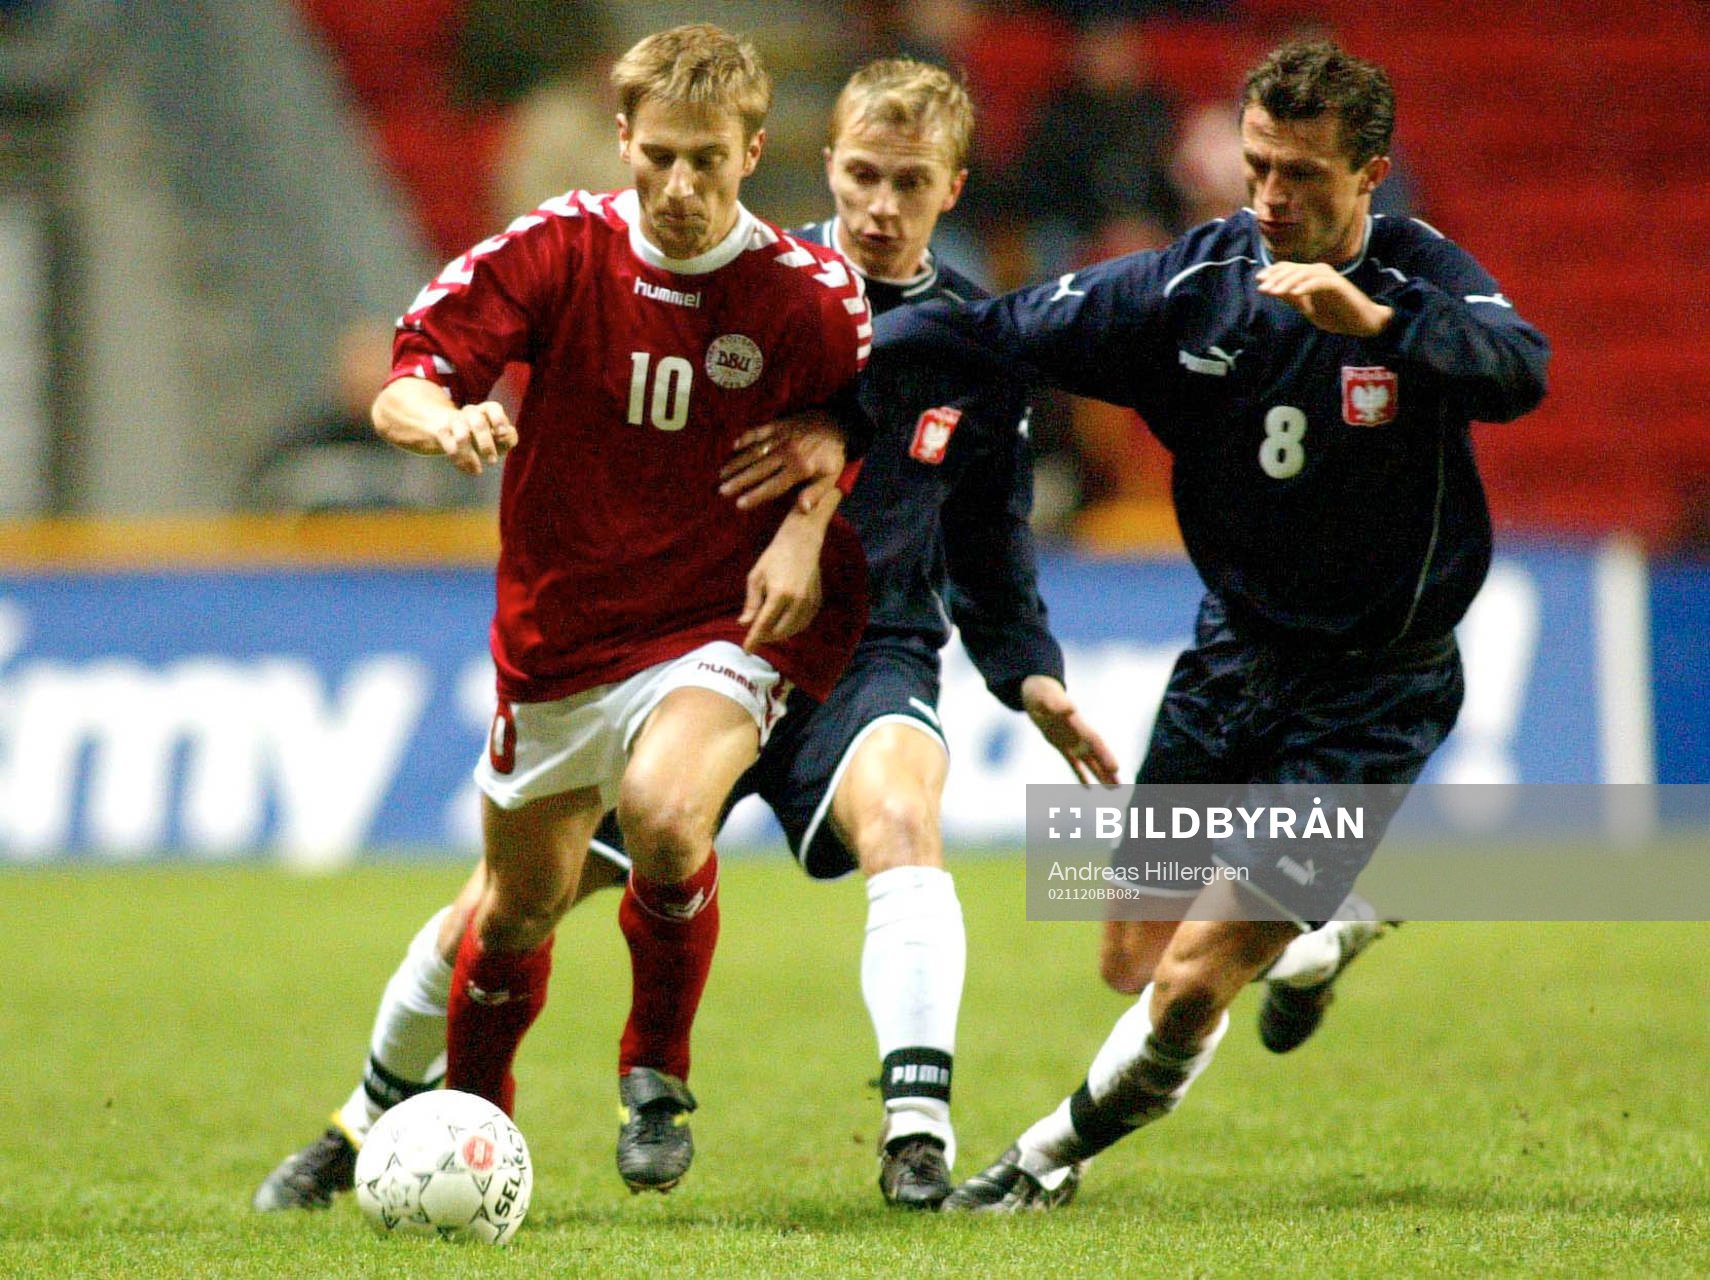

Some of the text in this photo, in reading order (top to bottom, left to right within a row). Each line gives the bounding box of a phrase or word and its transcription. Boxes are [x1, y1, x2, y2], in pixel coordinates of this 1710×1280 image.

[634, 276, 701, 309] hummel
[716, 349, 751, 373] DBU
[628, 351, 694, 432] 10
[1258, 405, 1308, 480] 8
